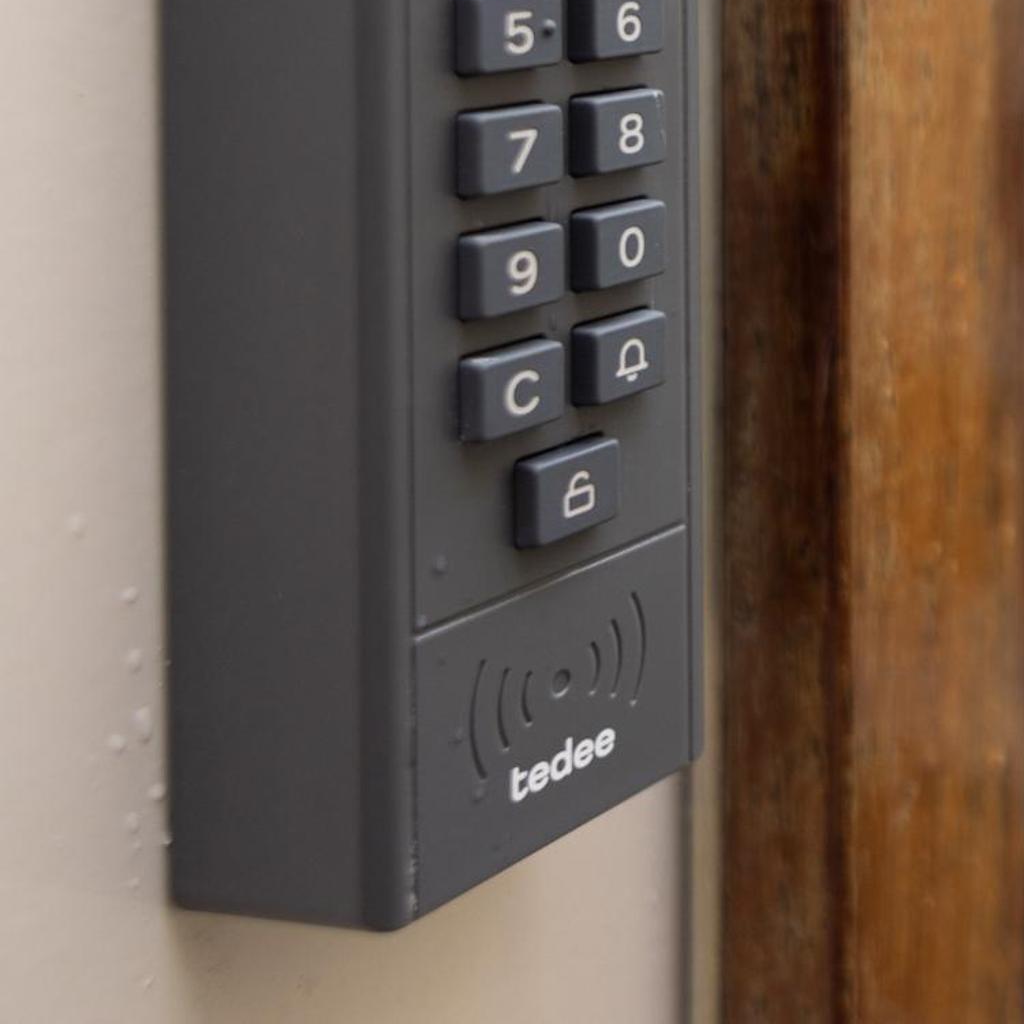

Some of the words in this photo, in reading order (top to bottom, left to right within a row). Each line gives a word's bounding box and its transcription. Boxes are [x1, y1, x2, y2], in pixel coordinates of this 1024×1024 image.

[504, 10, 536, 56] 5
[615, 0, 643, 43] 6
[507, 128, 539, 175] 7
[618, 112, 646, 156] 8
[618, 226, 646, 269] 0
[507, 250, 539, 296] 9
[503, 369, 540, 417] C
[509, 726, 617, 804] tedee
